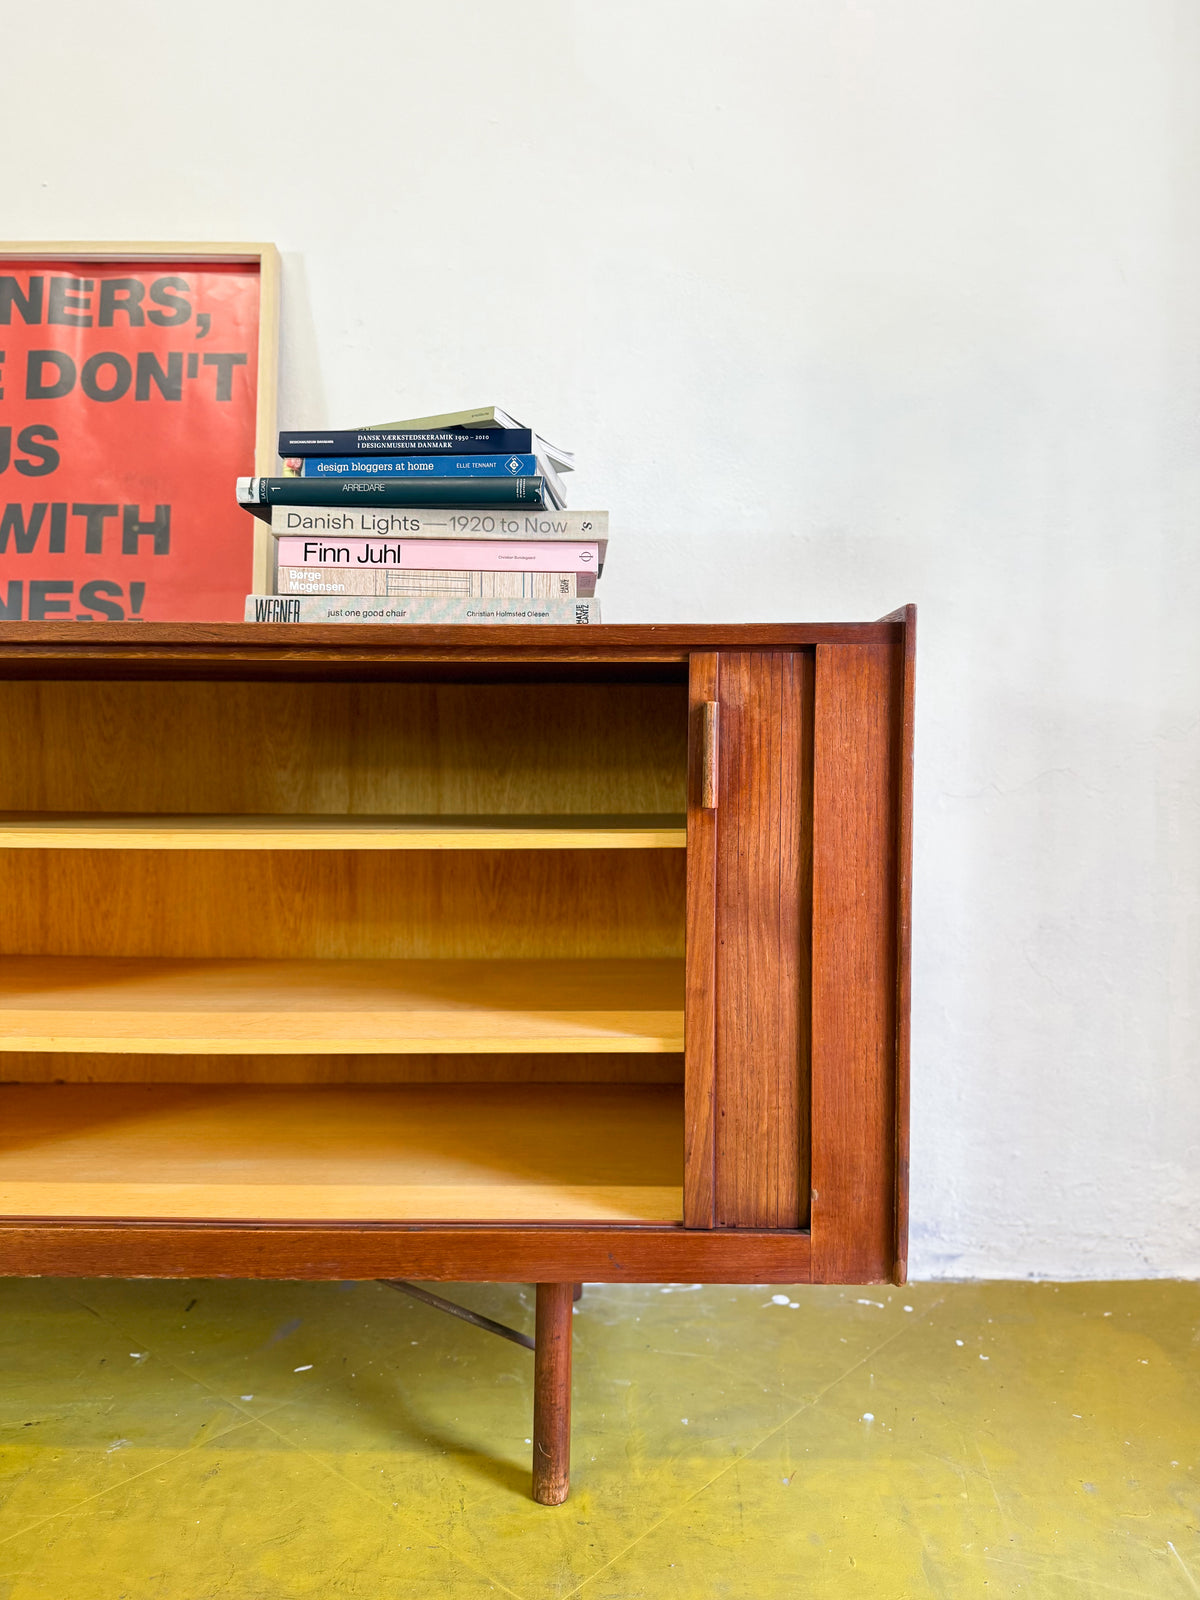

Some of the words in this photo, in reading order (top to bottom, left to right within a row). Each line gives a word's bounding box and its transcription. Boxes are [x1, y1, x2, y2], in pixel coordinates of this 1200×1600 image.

[0, 276, 211, 339] NERS,
[25, 349, 247, 402] DON'T
[382, 433, 454, 441] VÆRKSTEDSKERAMIK
[455, 434, 469, 442] 1950
[0, 424, 60, 477] S
[417, 441, 453, 449] DANMARK
[317, 463, 349, 473] design
[351, 462, 393, 473] bloggers
[395, 462, 405, 471] at
[407, 461, 434, 471] home
[342, 483, 385, 492] ARREDARE
[0, 502, 171, 555] WITH
[287, 513, 354, 530] Danish
[361, 514, 420, 535] Lights
[449, 516, 495, 532] 1920
[501, 517, 519, 534] to
[525, 517, 568, 534] Now
[303, 542, 350, 563] Finn
[357, 544, 401, 564] Juhl
[289, 570, 321, 582] Børge
[289, 582, 345, 592] Mogensen
[255, 599, 300, 622] WEGNER
[327, 609, 343, 618] just
[362, 609, 383, 619] good
[385, 609, 406, 617] chair
[496, 610, 526, 618] Holmsted
